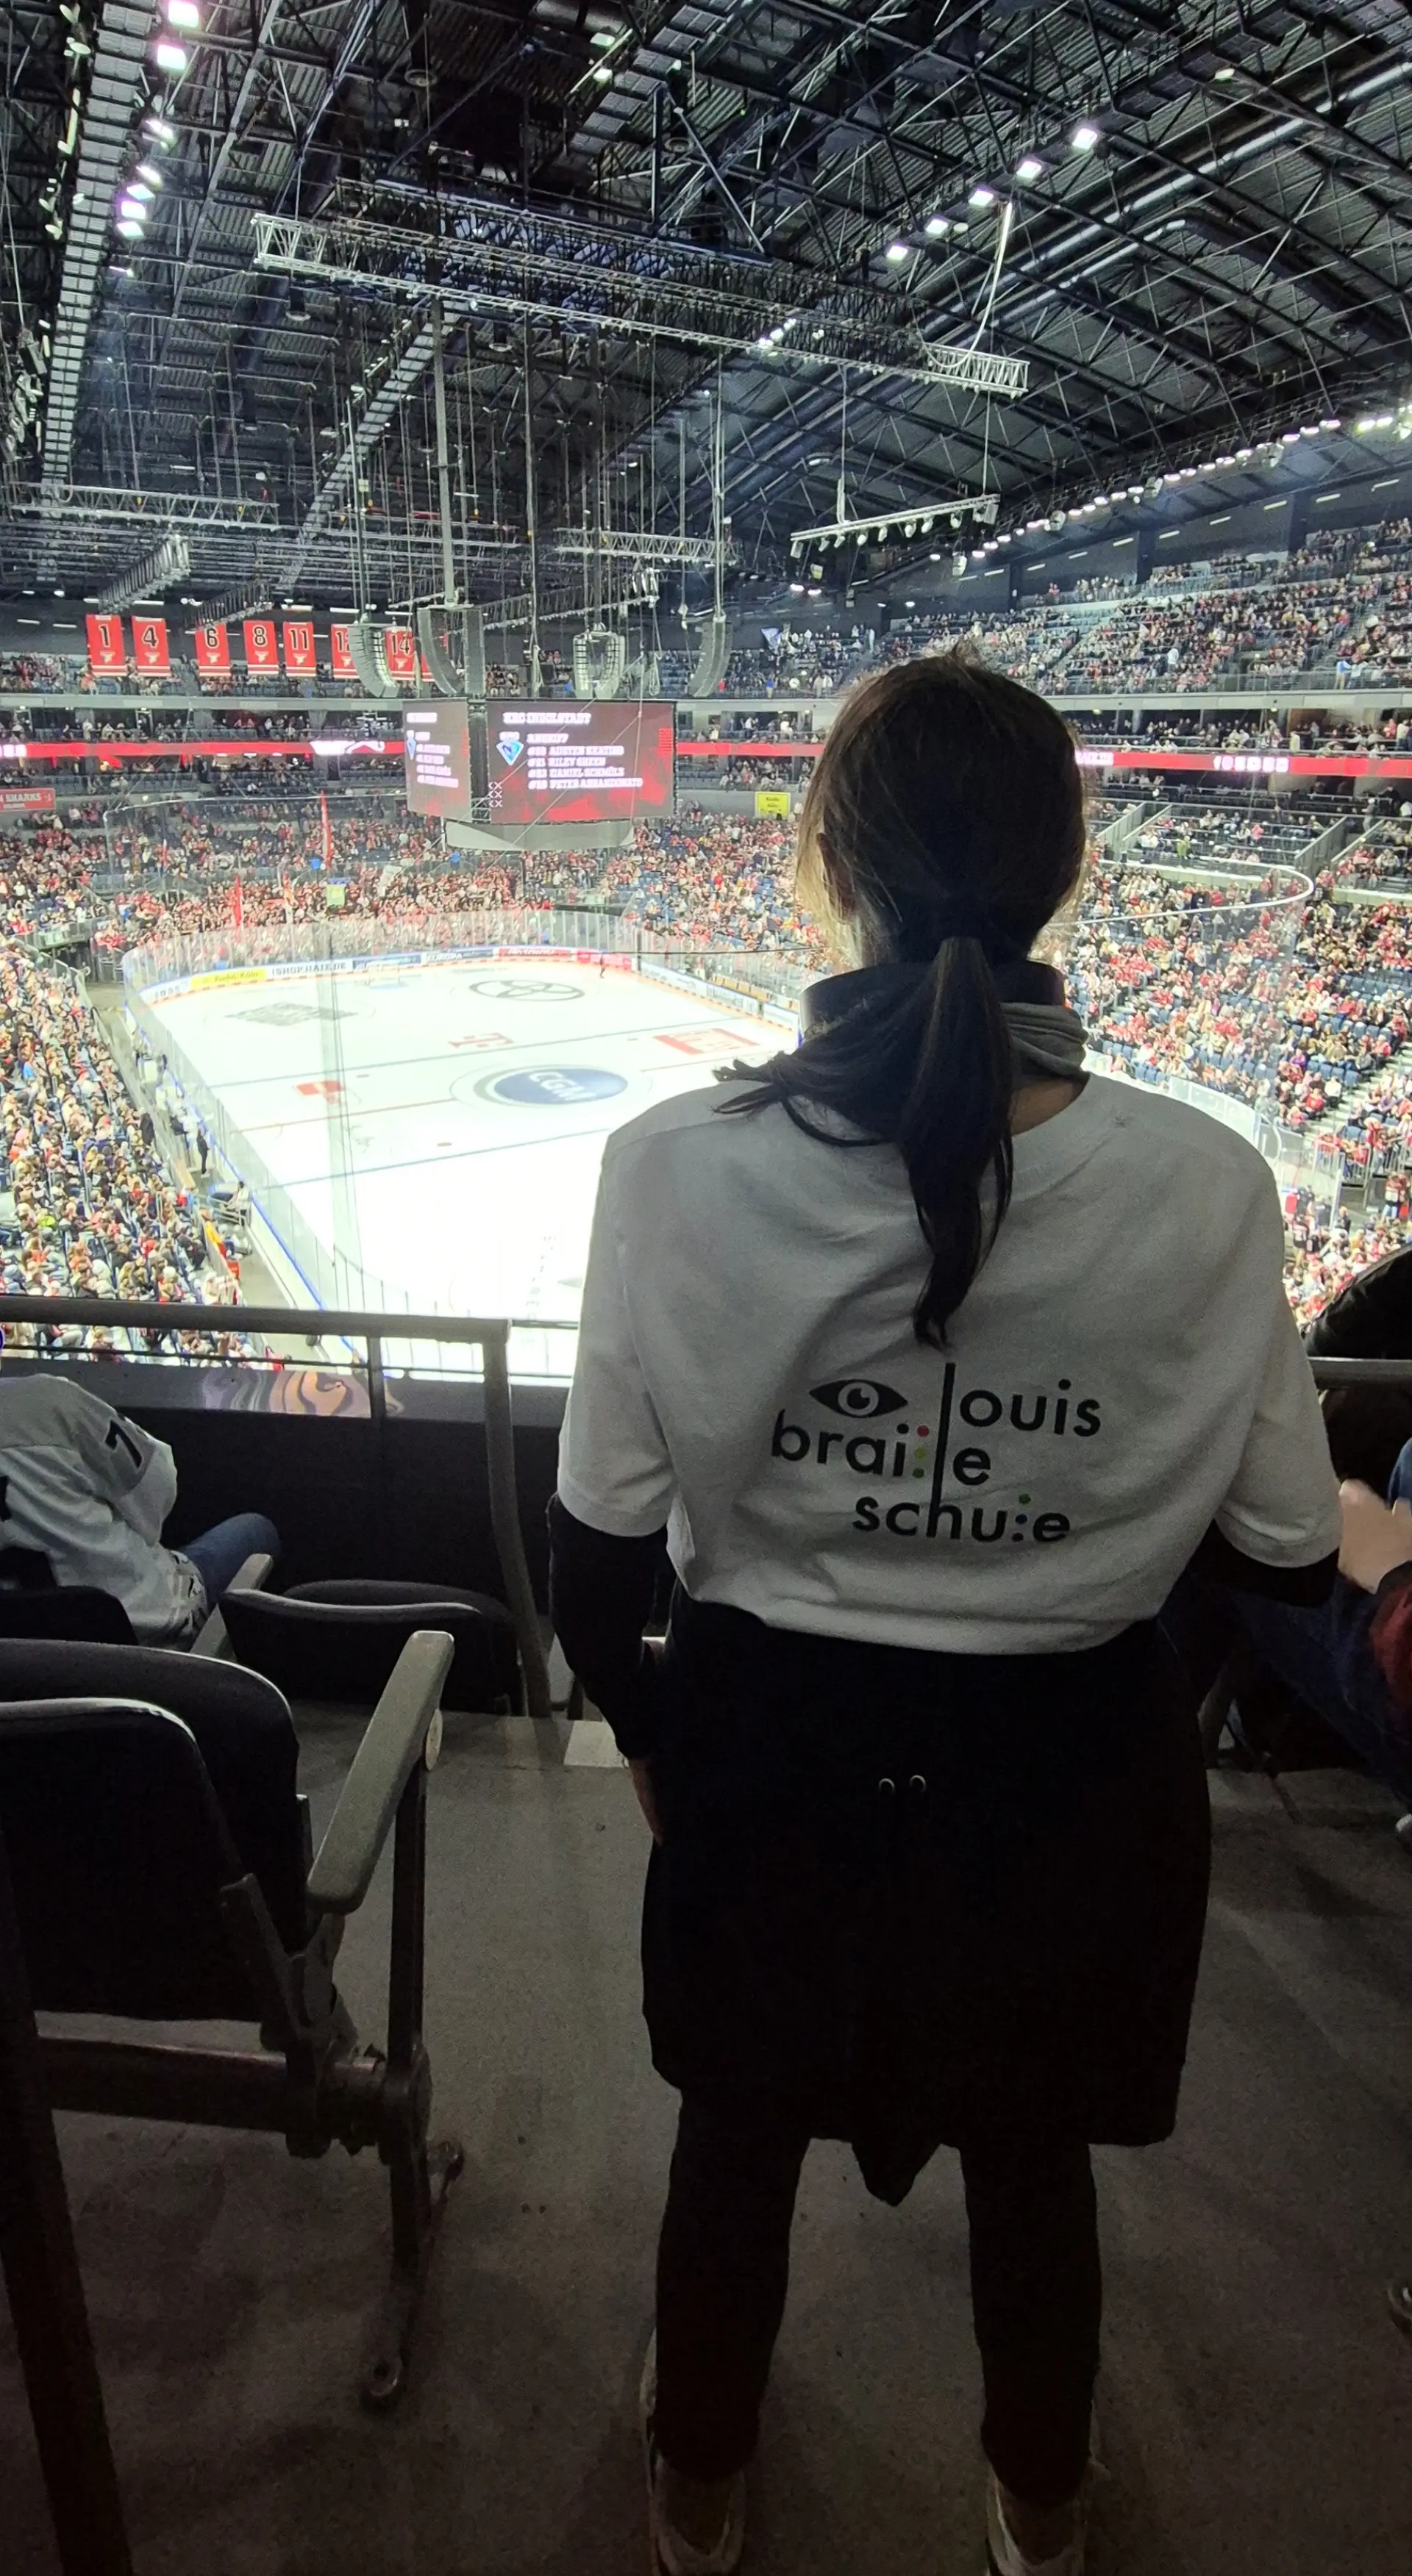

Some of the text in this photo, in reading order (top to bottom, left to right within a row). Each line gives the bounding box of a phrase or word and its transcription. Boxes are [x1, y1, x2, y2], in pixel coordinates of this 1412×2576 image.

[99, 624, 110, 647] 1
[142, 625, 159, 648] 4
[204, 627, 219, 648] 6
[253, 626, 268, 646] 8
[288, 629, 310, 650] 11
[391, 633, 412, 656] 14
